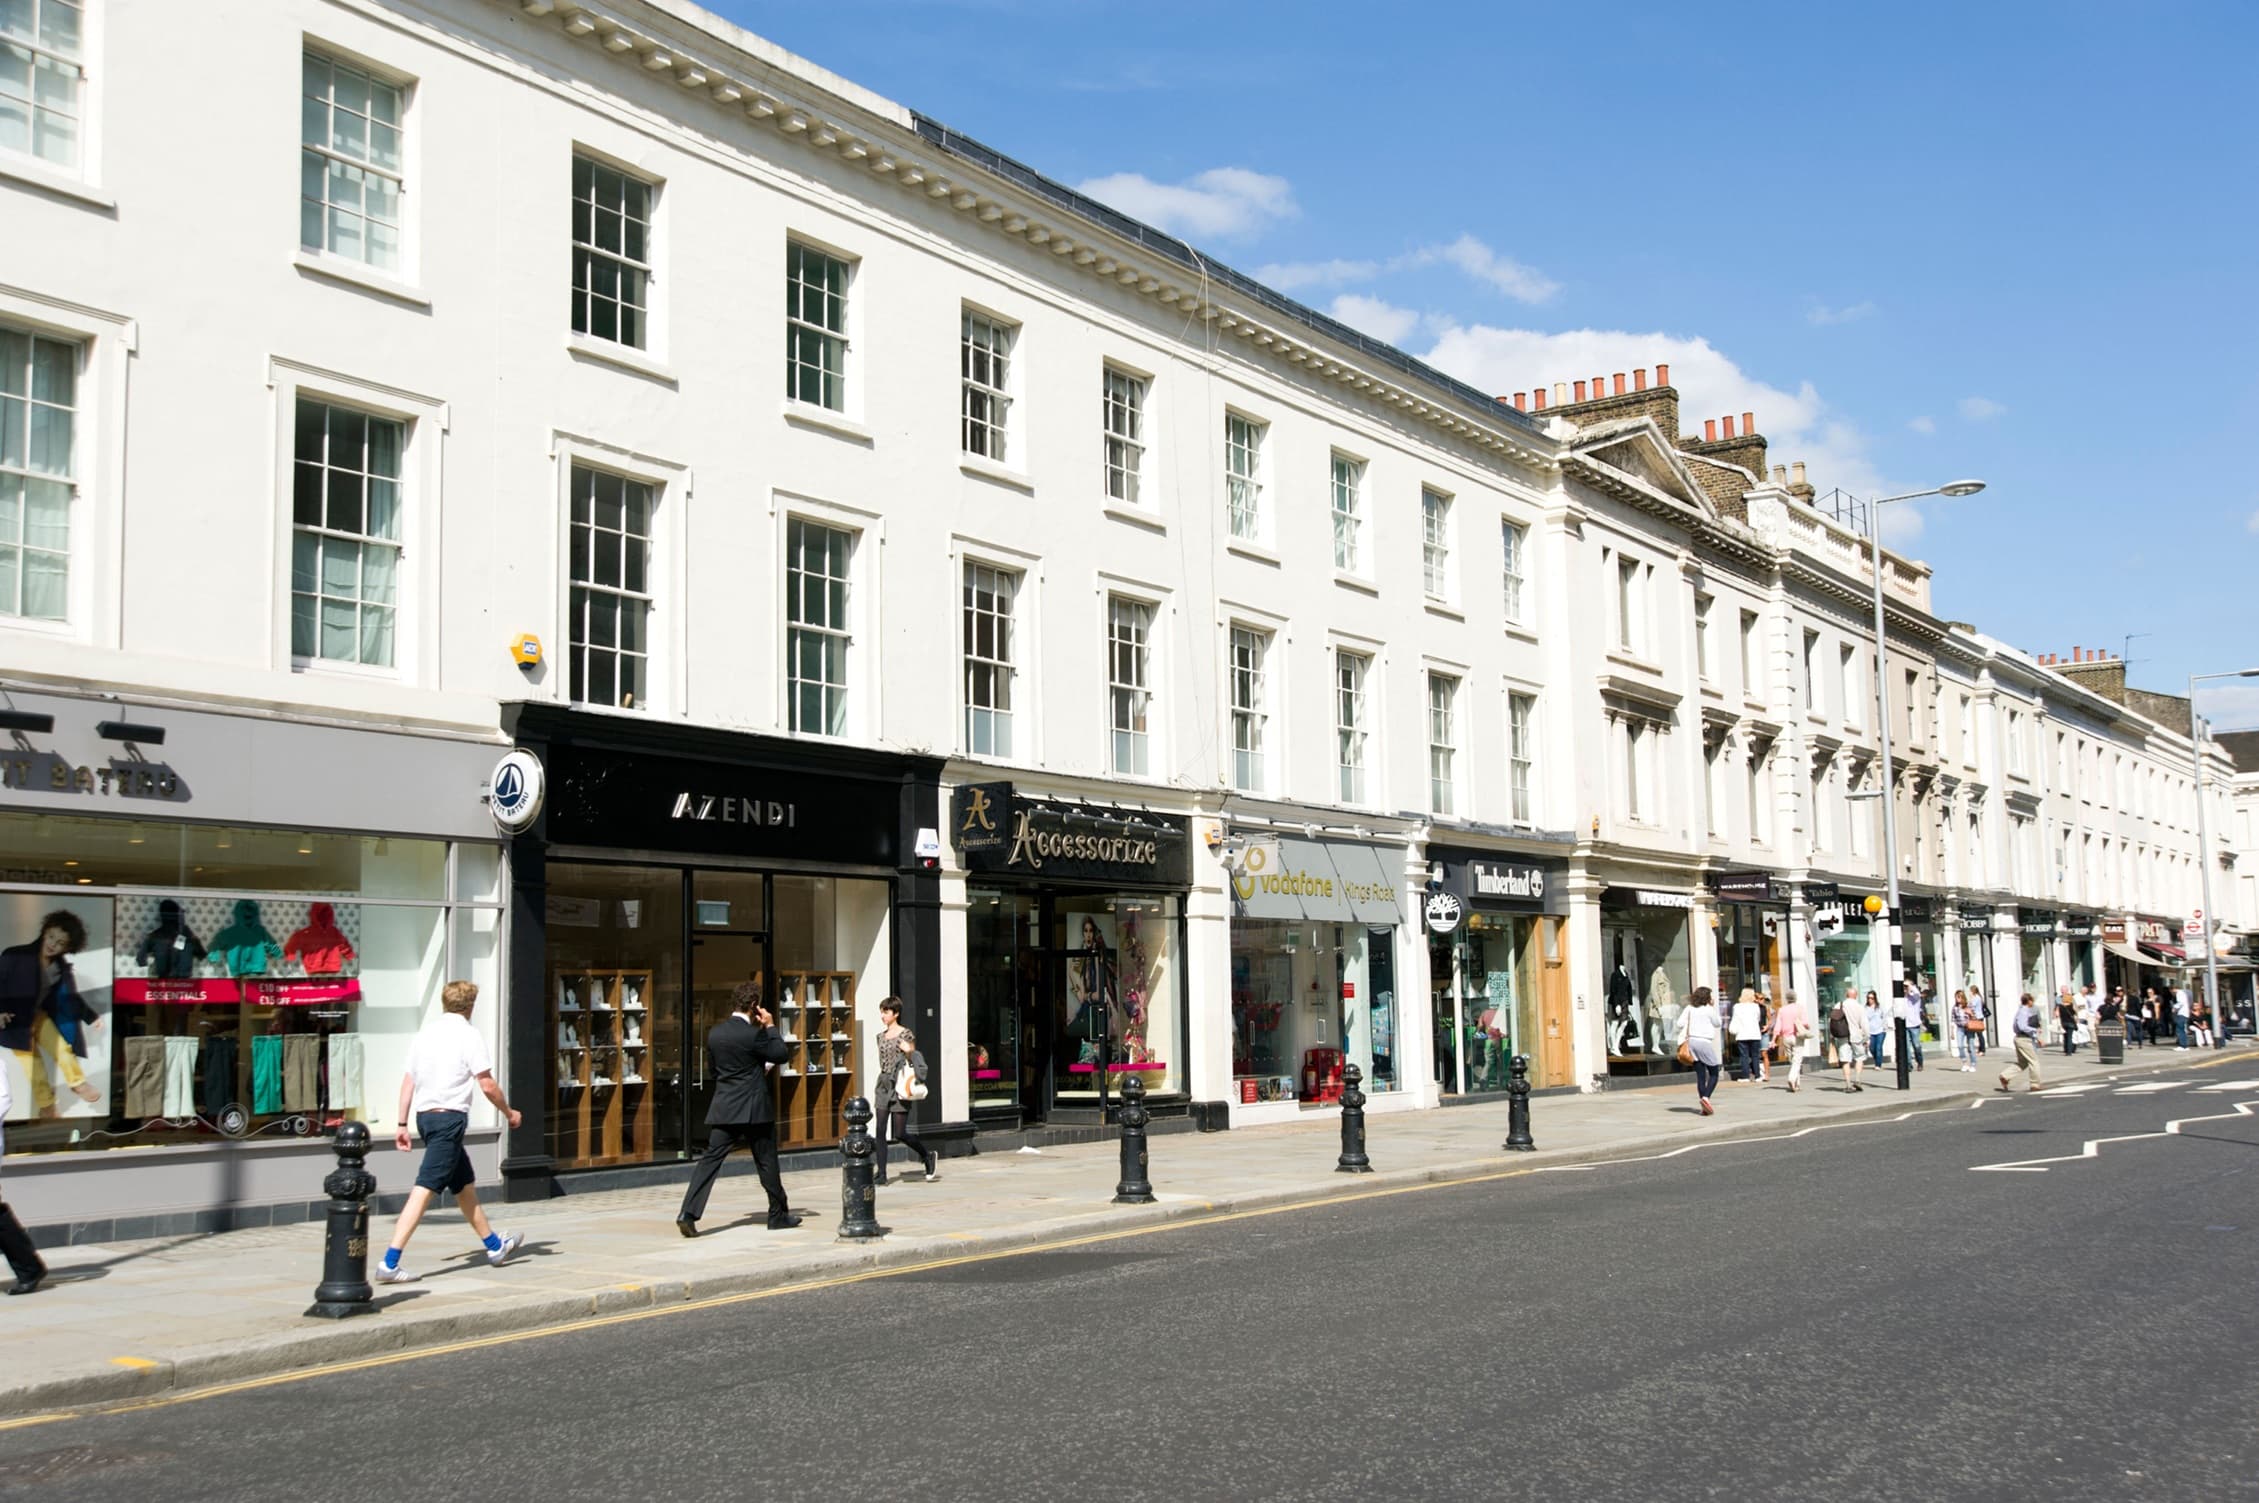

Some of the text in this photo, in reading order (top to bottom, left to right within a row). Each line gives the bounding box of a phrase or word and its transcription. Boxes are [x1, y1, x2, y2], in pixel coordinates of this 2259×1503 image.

[51, 762, 178, 798] BATEAU
[507, 791, 530, 817] BATEAU
[671, 791, 795, 828] AZENDI
[1260, 869, 1333, 898] vodafone
[1372, 882, 1395, 903] Road
[1474, 864, 1531, 897] Timberland
[145, 990, 208, 1001] ESSENTIALS
